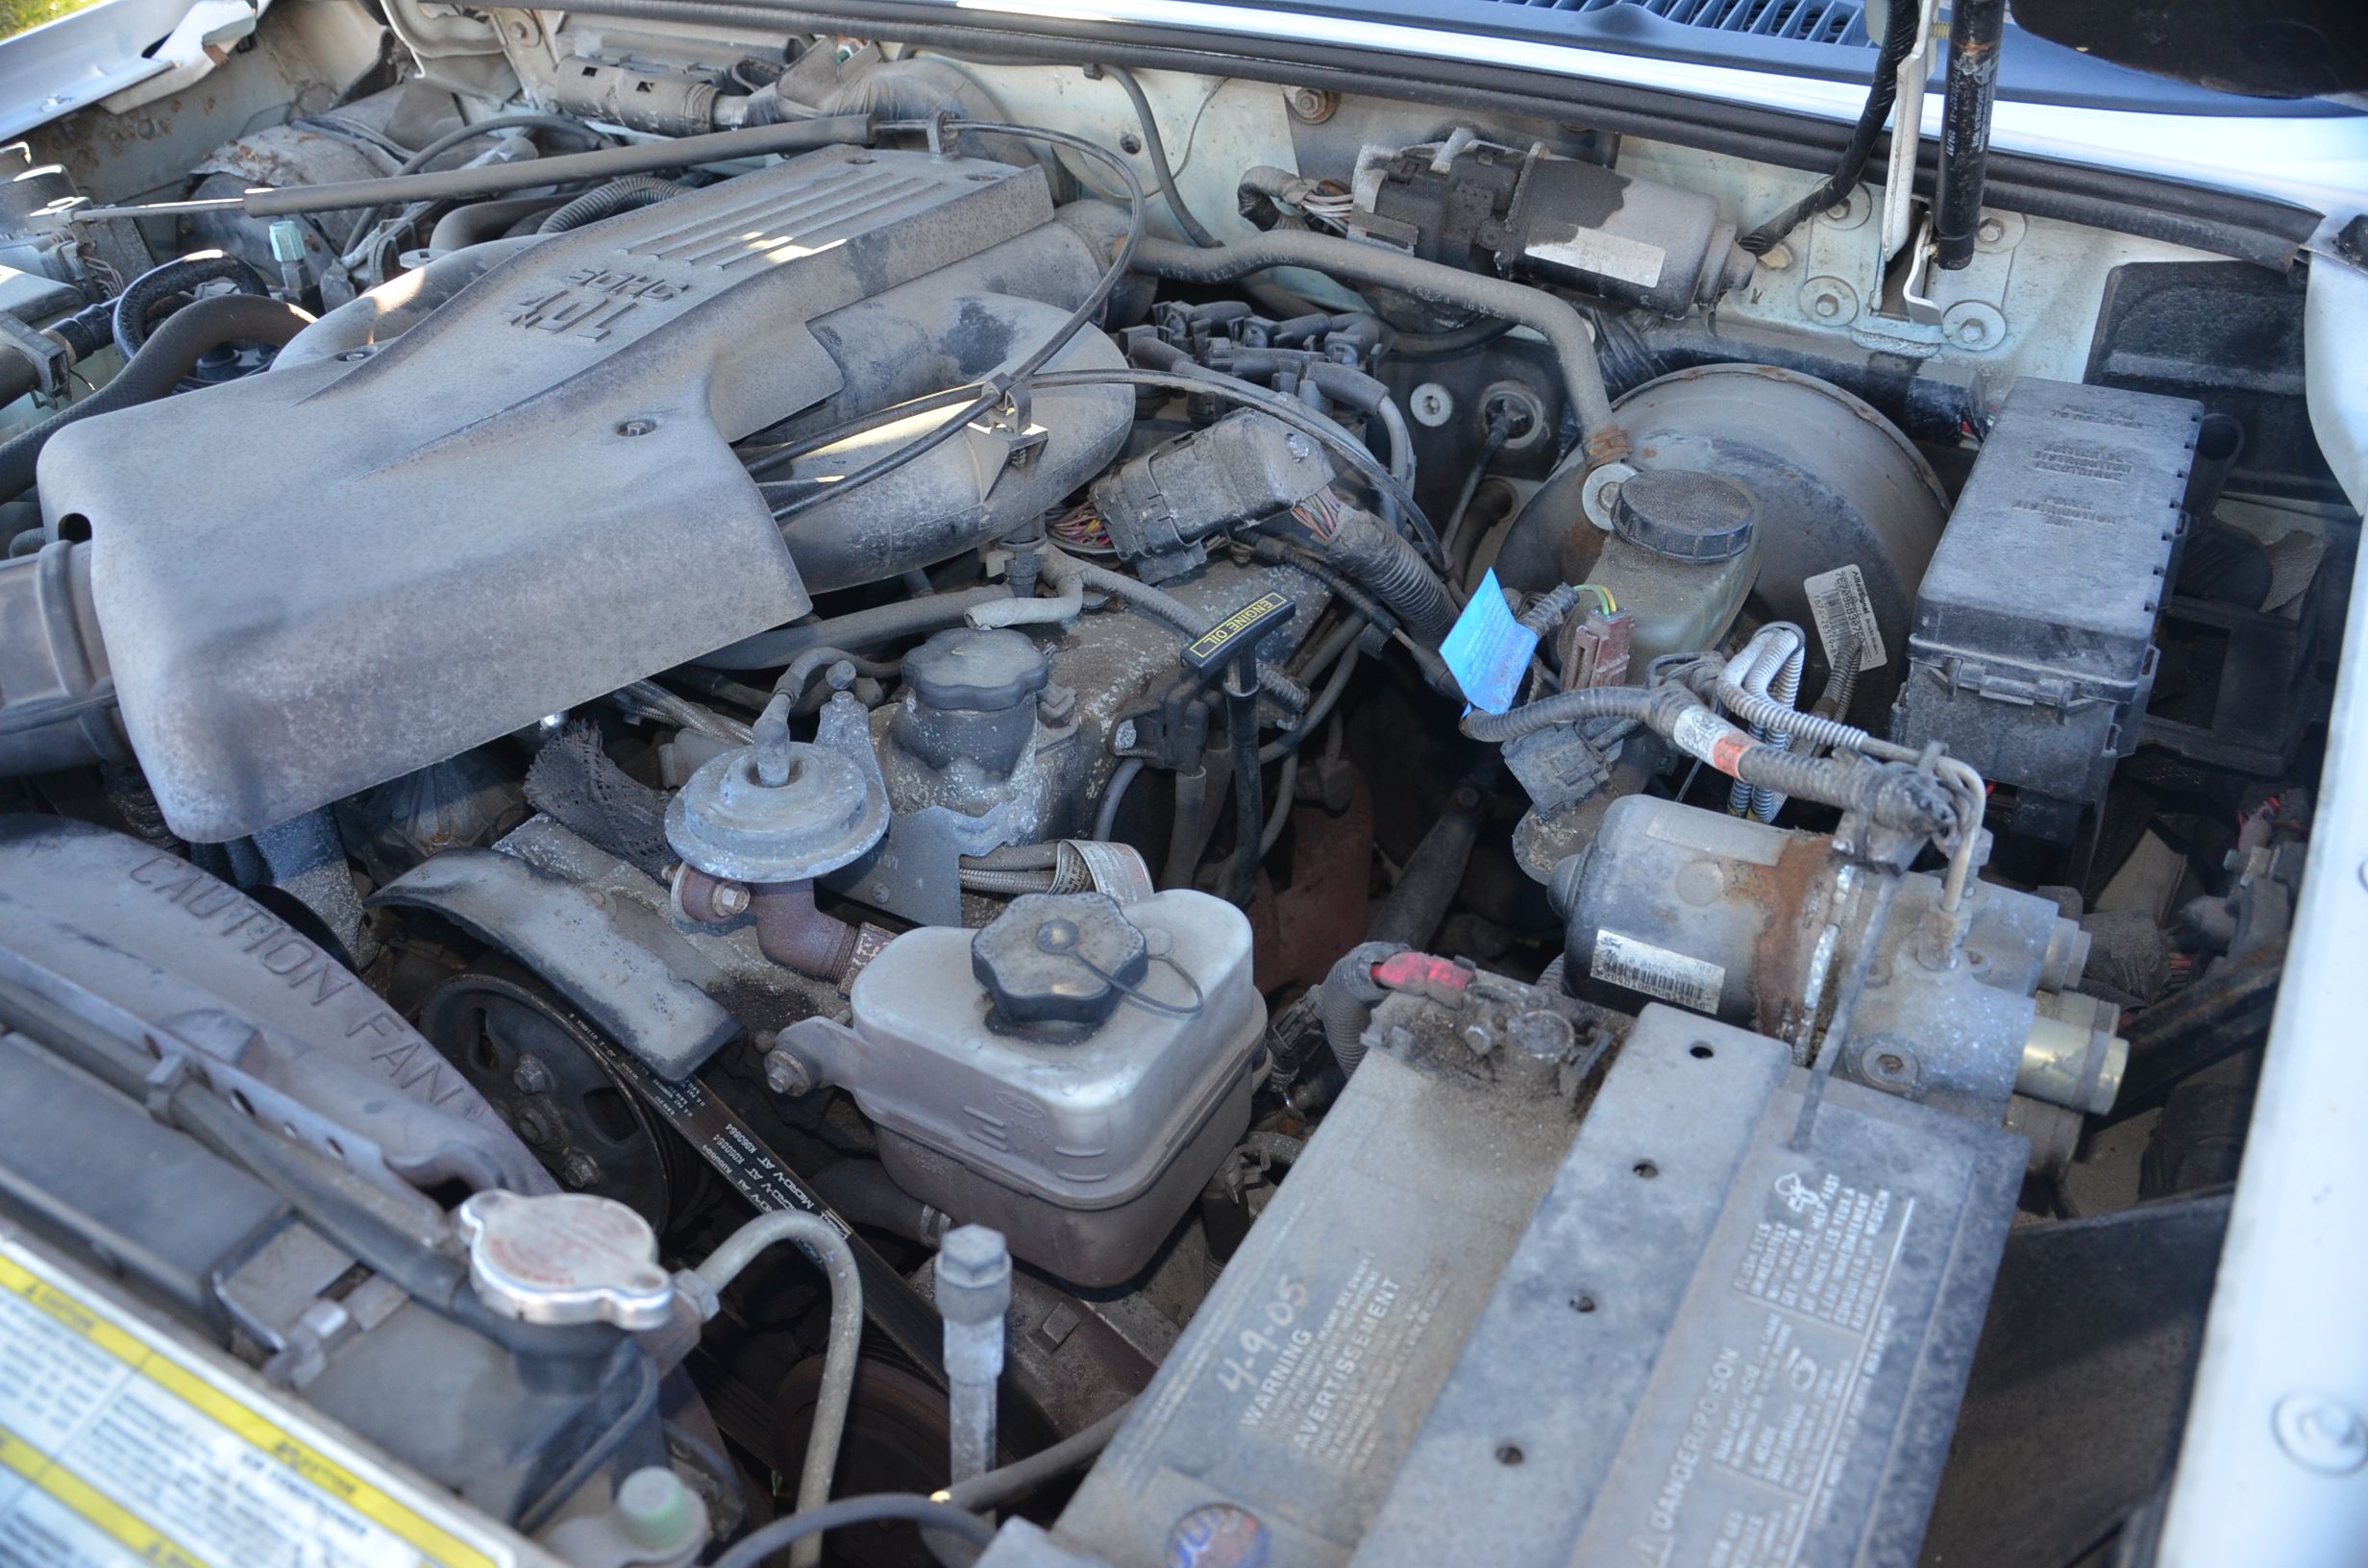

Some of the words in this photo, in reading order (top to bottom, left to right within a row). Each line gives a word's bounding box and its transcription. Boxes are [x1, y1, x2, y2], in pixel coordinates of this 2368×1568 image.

[1226, 600, 1273, 631] ENGINE
[1203, 629, 1228, 645] OIL
[129, 855, 353, 1006] CAUTION
[344, 1010, 464, 1107] FAN
[744, 1163, 763, 1182] AT
[755, 1152, 775, 1171] AT
[773, 1168, 814, 1208] MICRO-V
[1240, 1329, 1312, 1427] WARNING
[1293, 1278, 1401, 1450] AVERTISSEMENT
